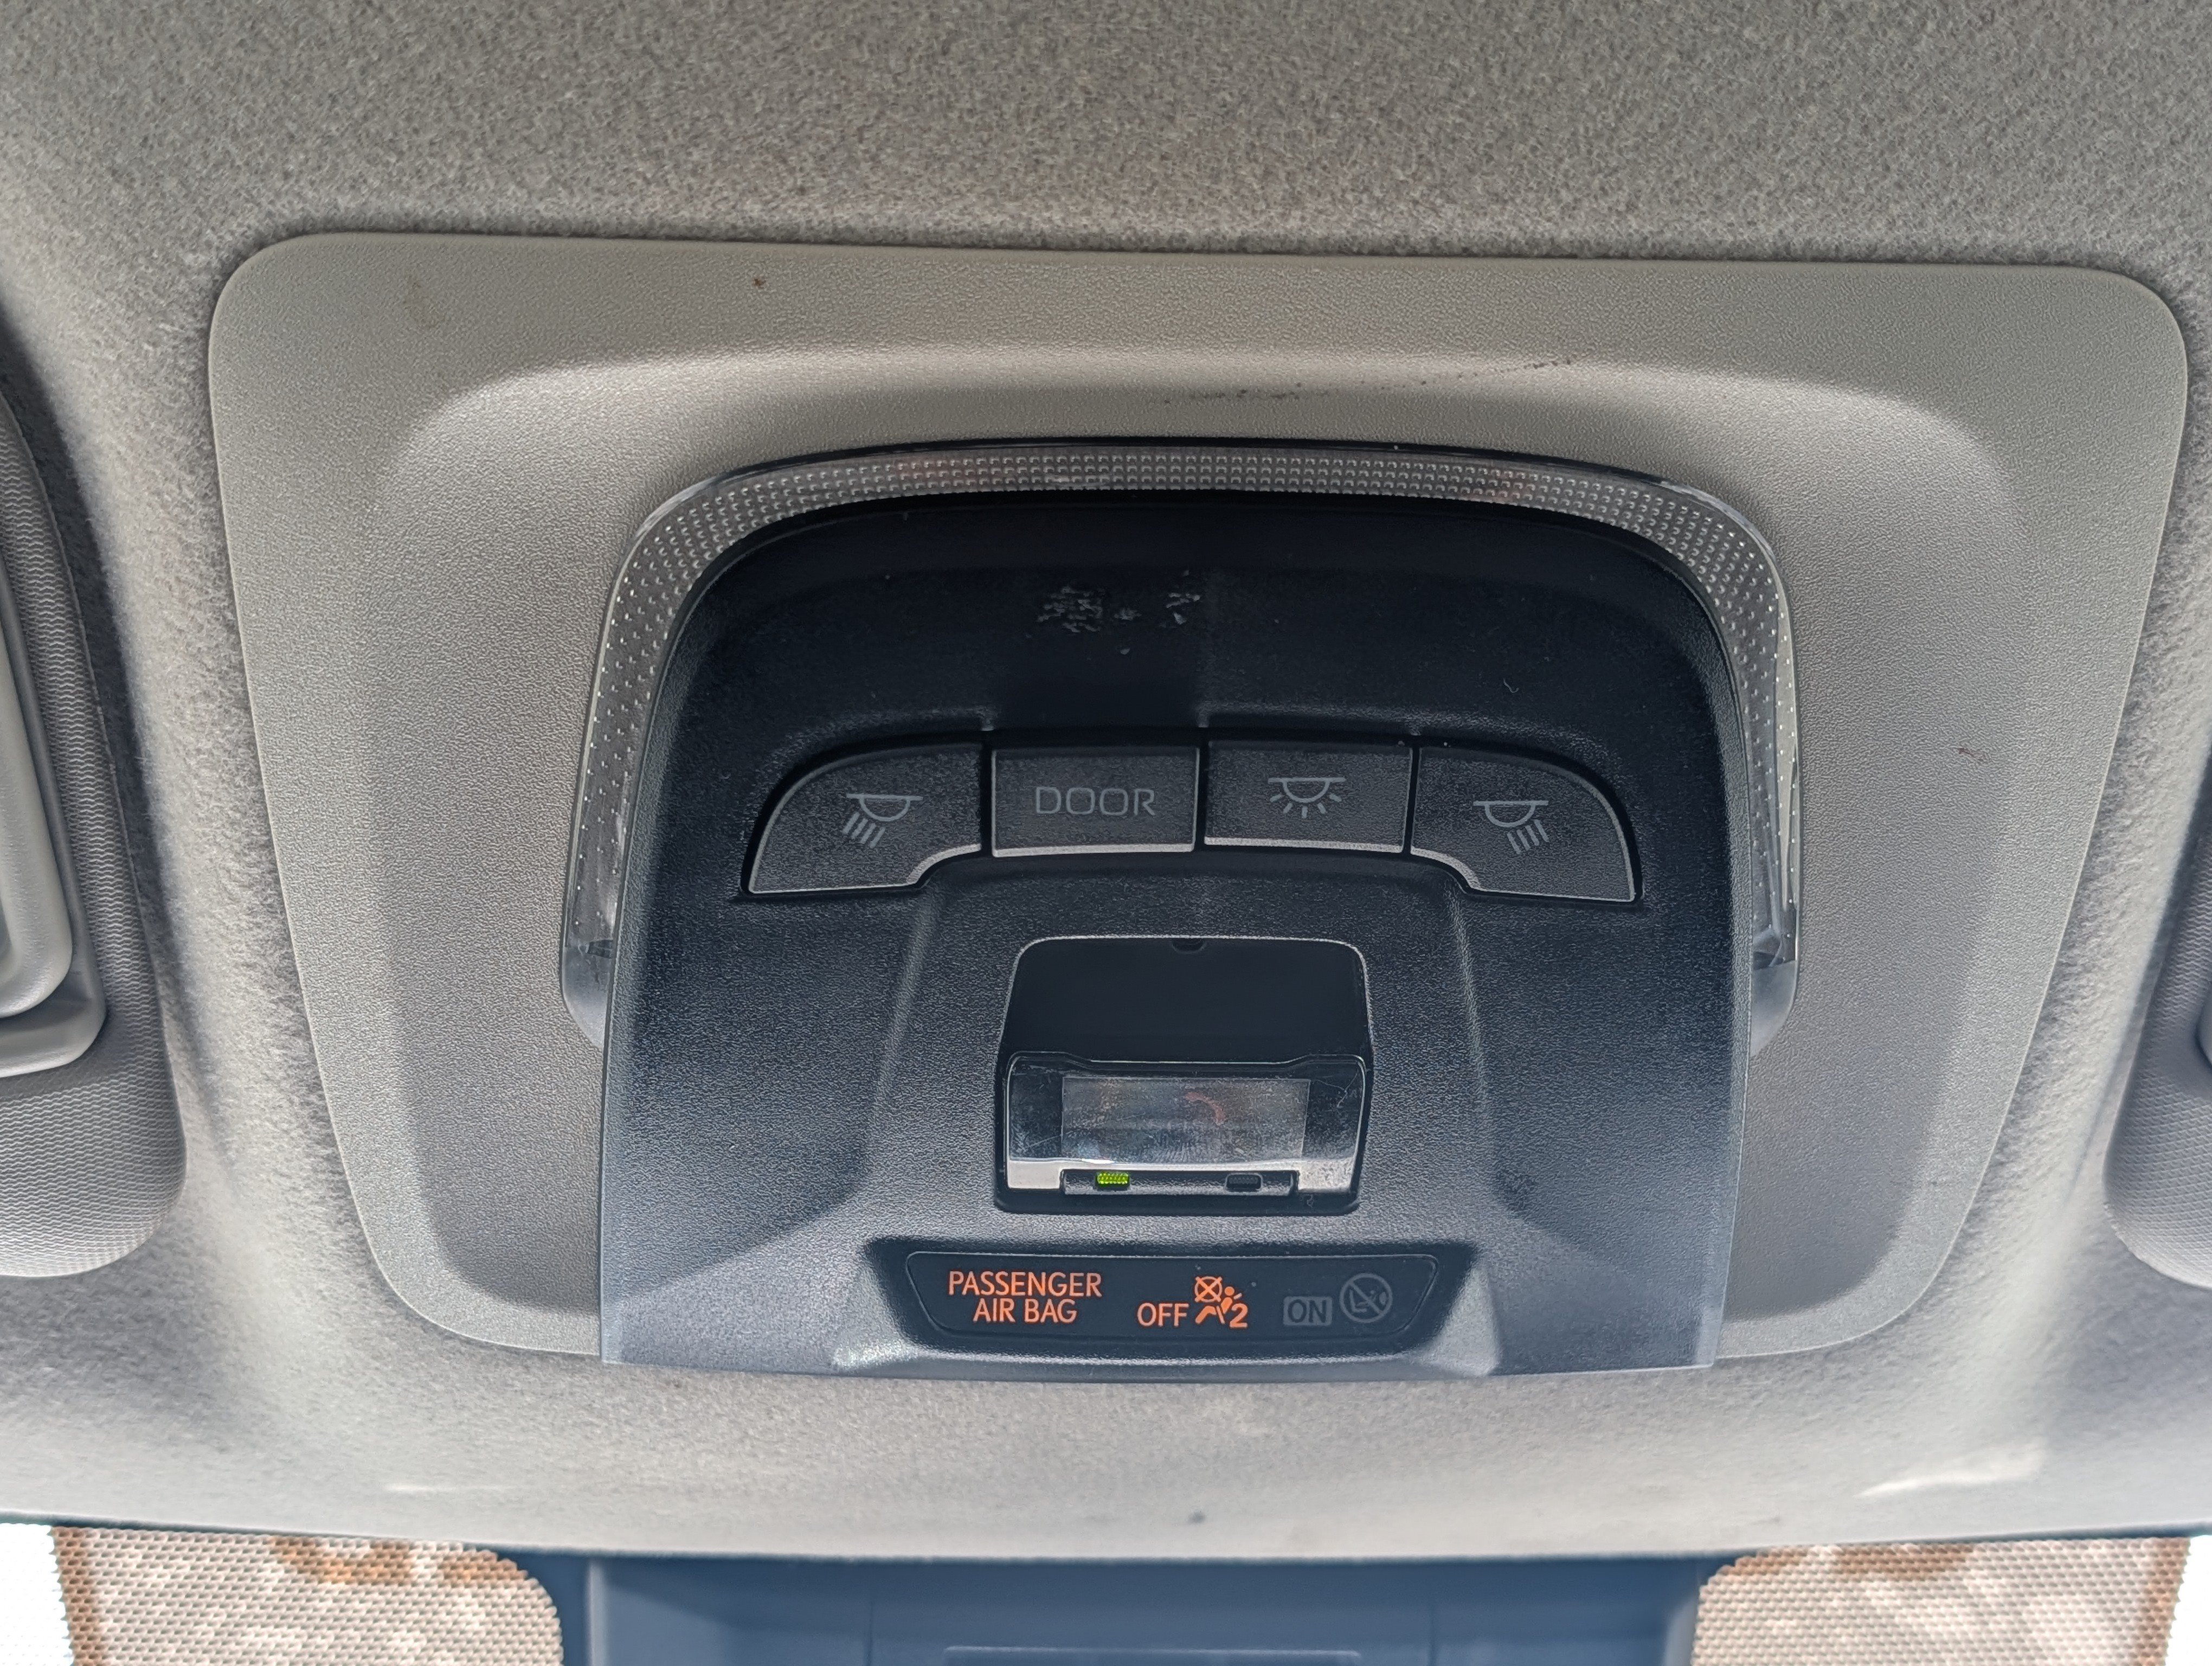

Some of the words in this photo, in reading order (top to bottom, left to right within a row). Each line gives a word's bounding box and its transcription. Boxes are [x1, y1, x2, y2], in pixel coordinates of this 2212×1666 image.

[1036, 786, 1155, 816] DOOR
[949, 1271, 1102, 1297] PASSENGER
[973, 1298, 1015, 1323] AIR
[1024, 1298, 1077, 1323] BAG
[1137, 1302, 1189, 1327] OFF
[1229, 1303, 1248, 1328] 2
[1288, 1299, 1327, 1323] ON
